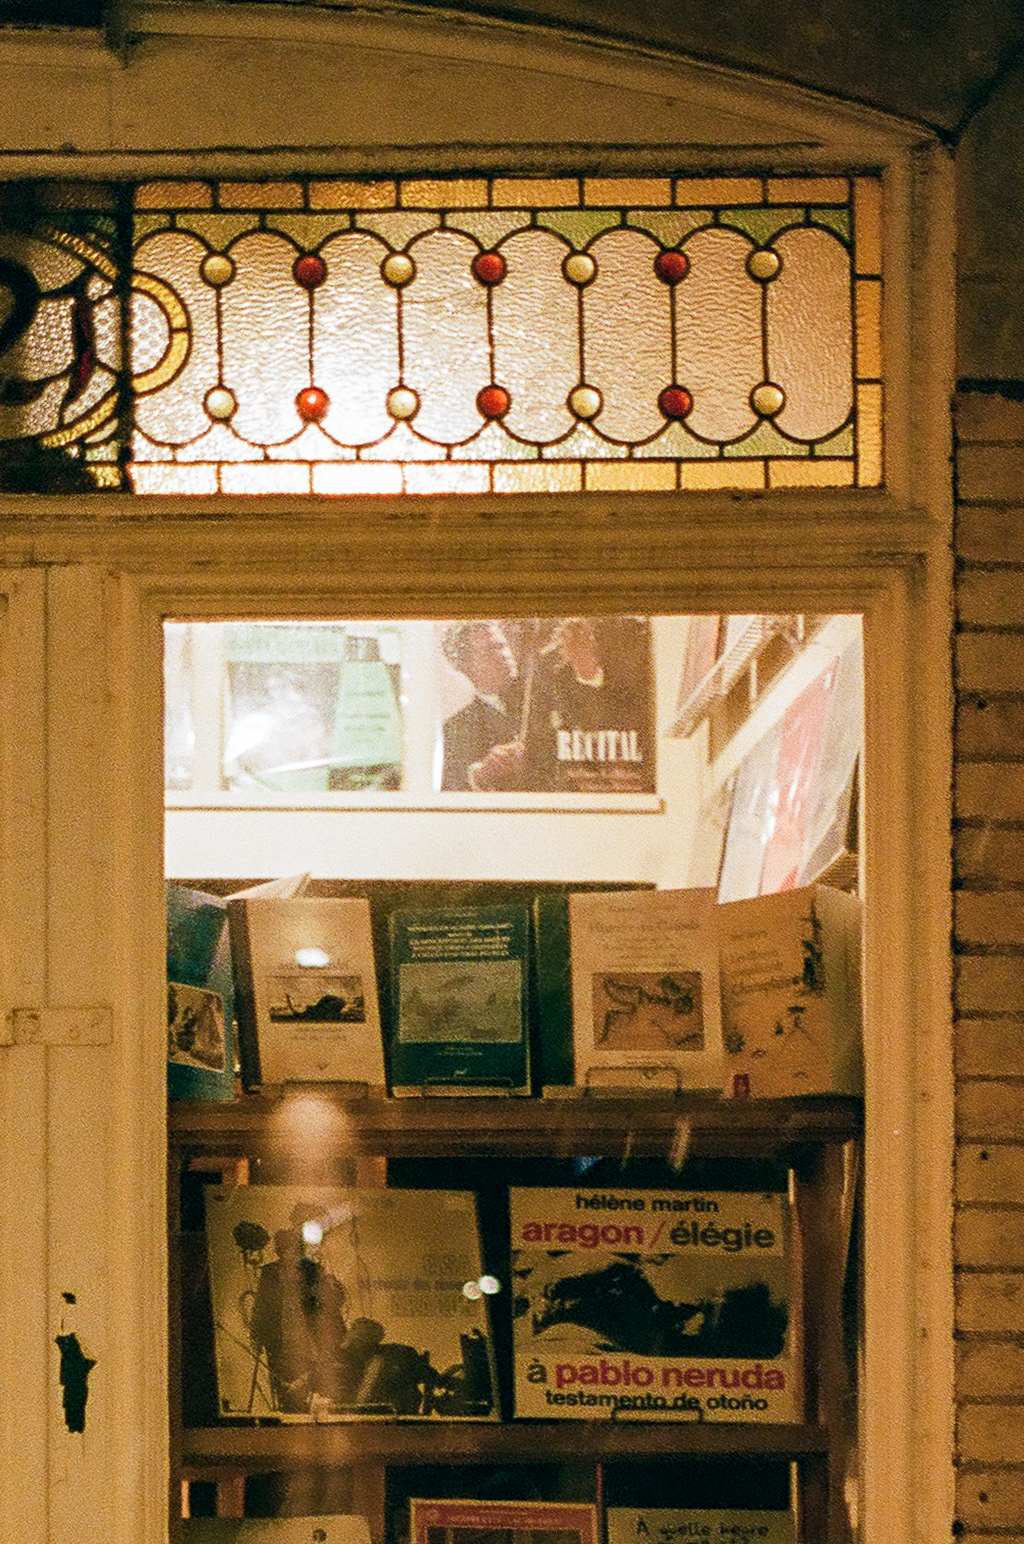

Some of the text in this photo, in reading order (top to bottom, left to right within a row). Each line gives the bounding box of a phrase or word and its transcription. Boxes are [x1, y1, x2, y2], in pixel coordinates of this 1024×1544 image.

[575, 1194, 719, 1213] hélène martin
[522, 1221, 645, 1249] aragon
[670, 1220, 776, 1252] élégie
[526, 1357, 786, 1391] à pablo neruda
[545, 1389, 769, 1411] testamento de otoño
